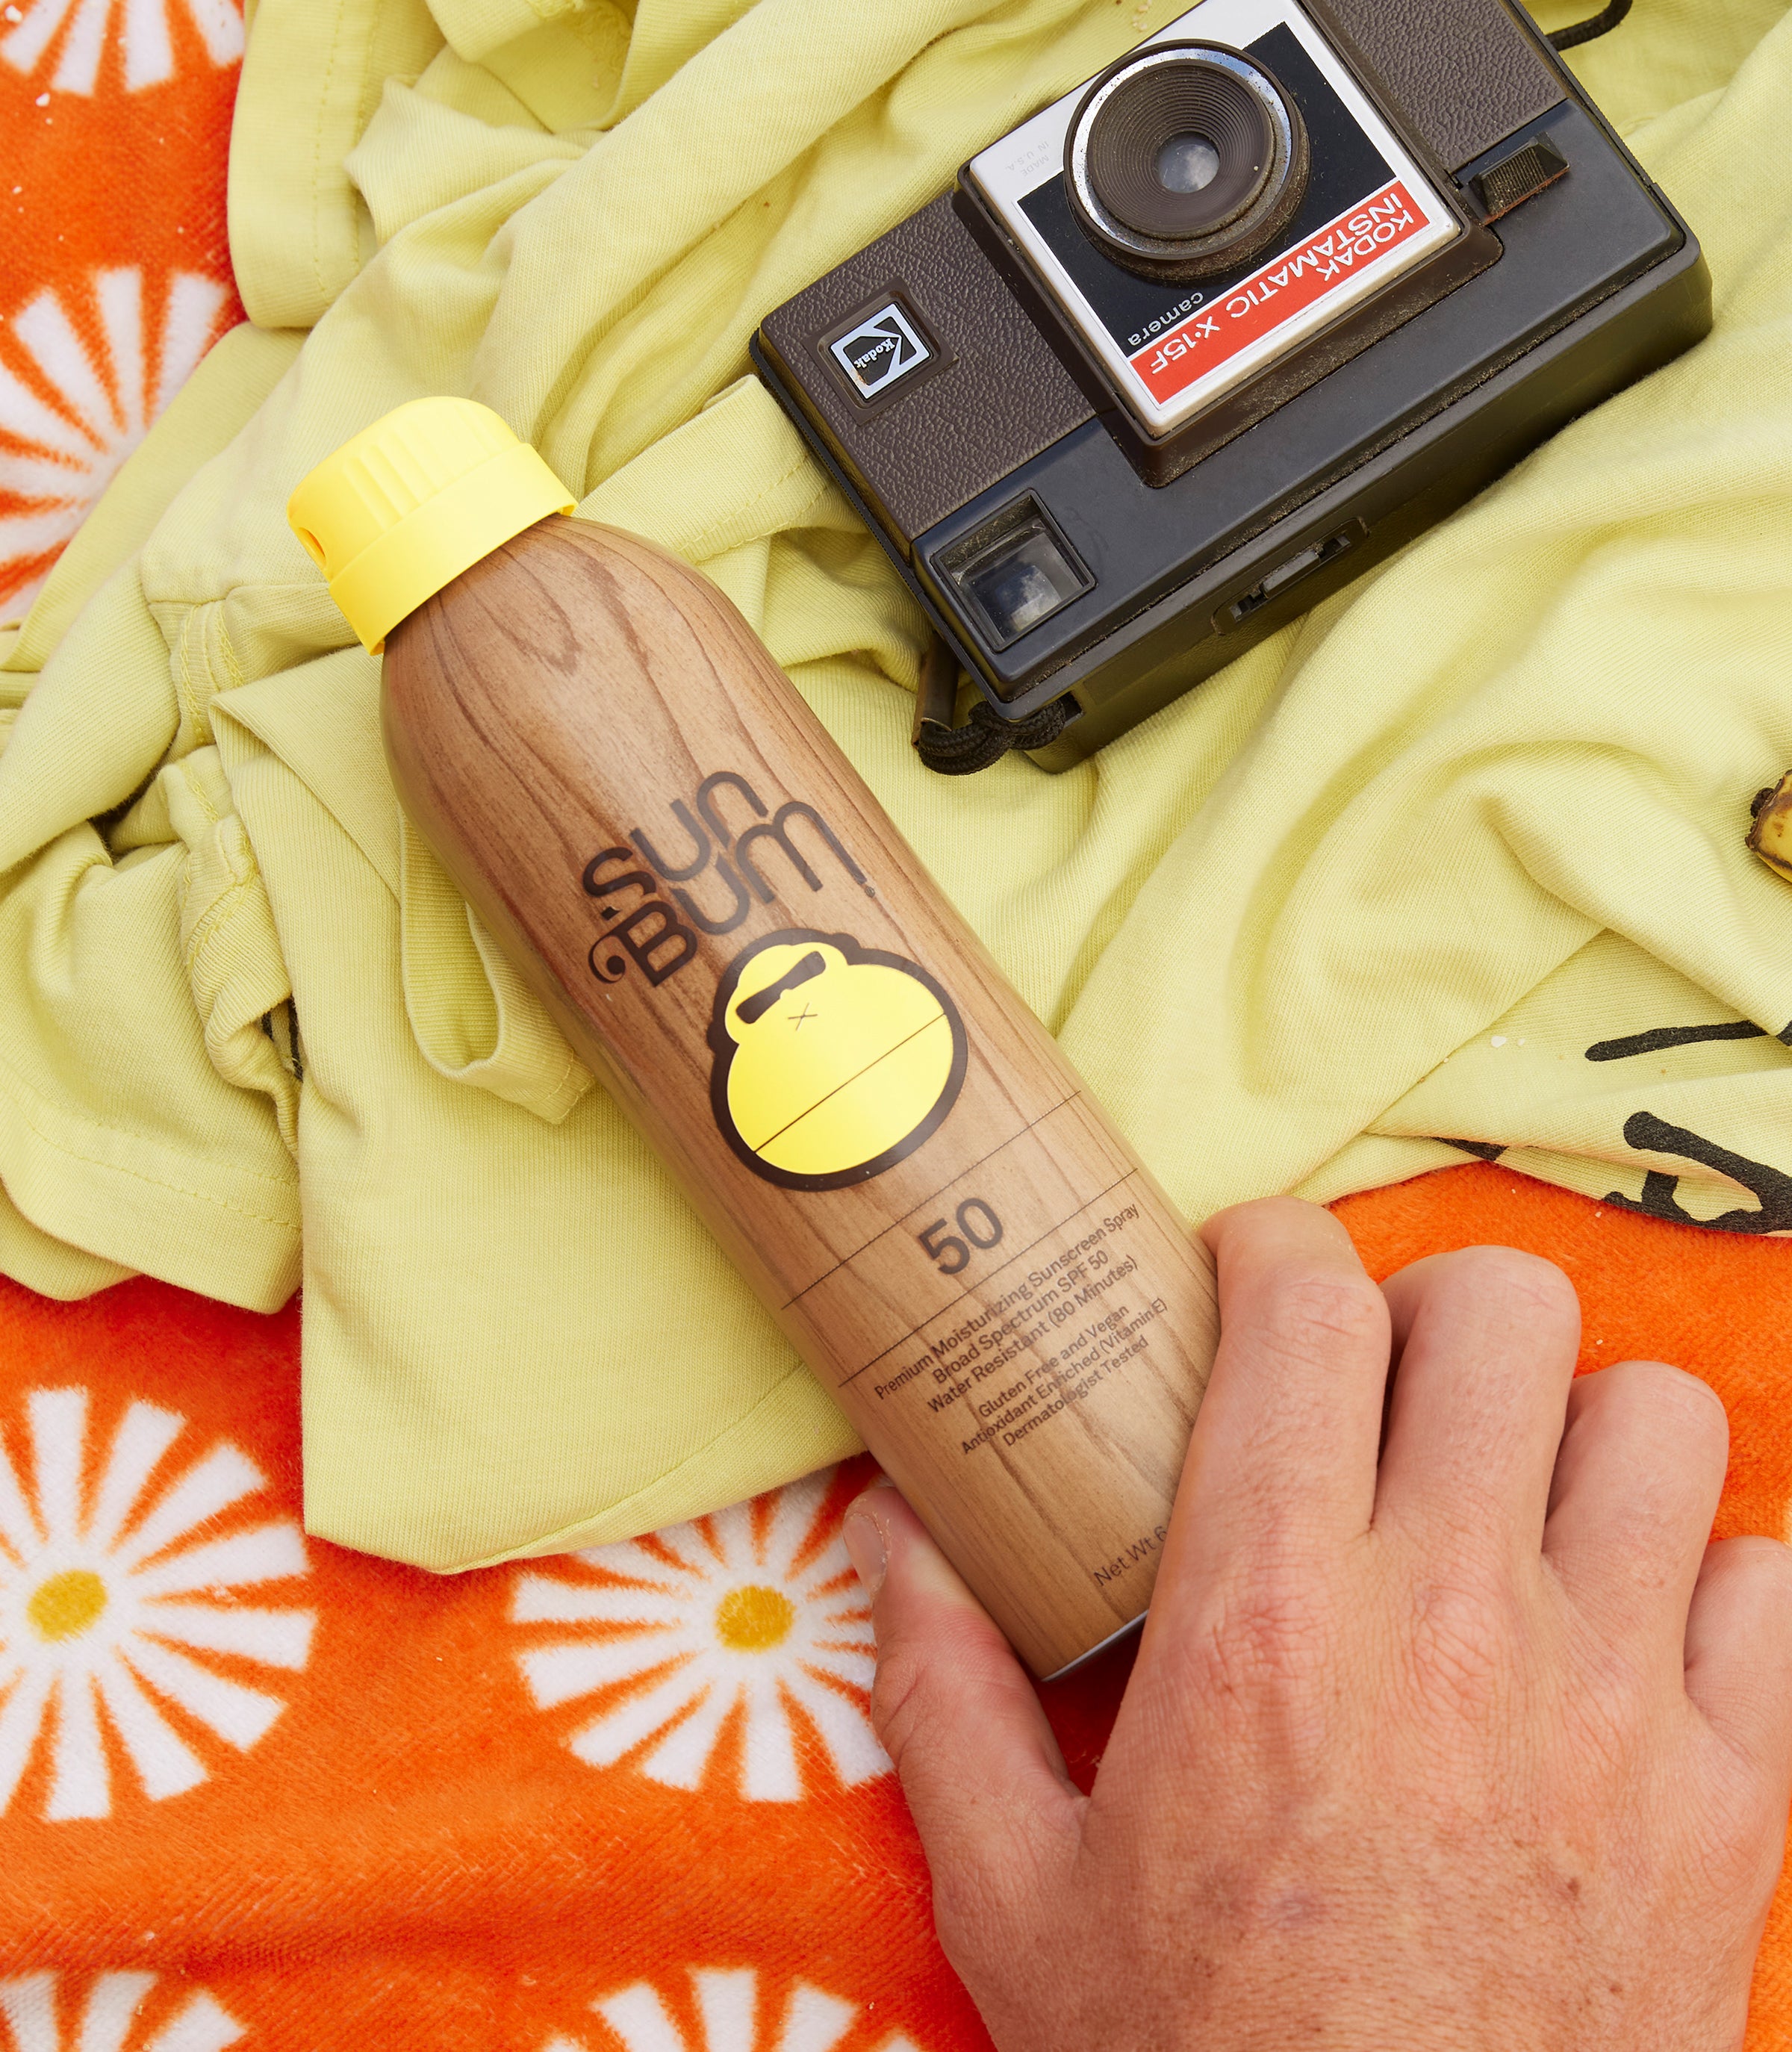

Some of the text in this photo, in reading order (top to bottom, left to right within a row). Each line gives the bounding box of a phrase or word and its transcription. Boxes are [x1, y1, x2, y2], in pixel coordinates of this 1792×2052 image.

[1021, 155, 1050, 176] MADE
[1037, 140, 1050, 152] IN
[1225, 192, 1404, 320] INSTAMATIC
[1315, 209, 1414, 282] KODAK
[853, 338, 896, 369] Kodak
[1127, 291, 1204, 347] camera
[916, 1197, 1004, 1276] 50
[874, 1203, 1140, 1400] Premium Moisturizing Sunscreen Spray
[927, 1254, 1139, 1414] Water Resistant (80 Minutes)
[932, 1249, 1109, 1384] Broad Spectrum SPF 50
[961, 1297, 1169, 1455] Antioxidant Enriched (Vitamin E)
[978, 1306, 1130, 1418] Gluten Free and Vegan
[1002, 1334, 1149, 1447] Dermatologist Tested
[1093, 1556, 1130, 1587] Net
[1125, 1537, 1157, 1561] Wt
